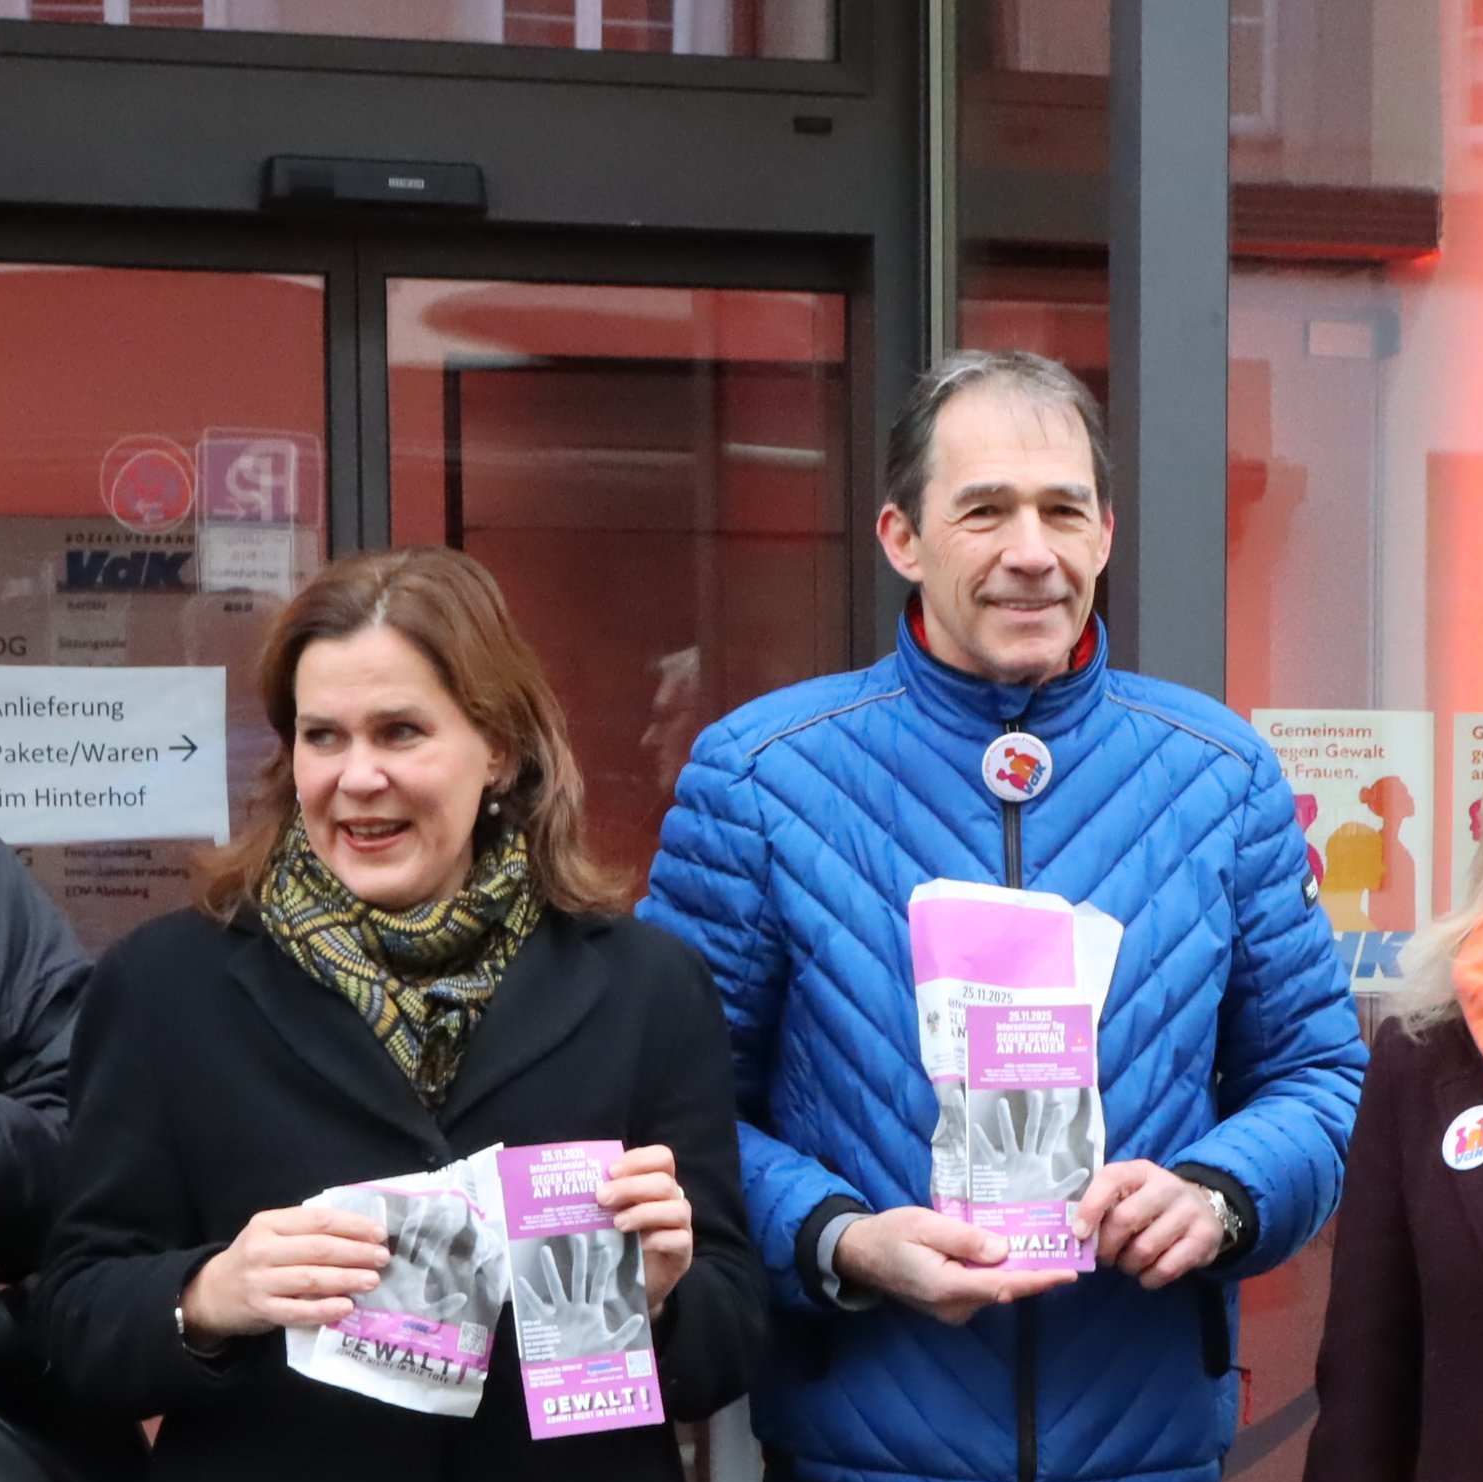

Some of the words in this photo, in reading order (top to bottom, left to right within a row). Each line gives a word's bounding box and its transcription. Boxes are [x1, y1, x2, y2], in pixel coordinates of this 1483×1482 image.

[65, 533, 196, 546] SOZIALVERBAND
[66, 551, 193, 589] VdK
[1270, 722, 1372, 738] Gemeinsam
[1325, 744, 1385, 758] Gewalt
[1295, 765, 1359, 779] Frauen.
[34, 786, 147, 808] Hinterhof
[962, 985, 1014, 1004] 25.11.2025
[1009, 1010, 1052, 1022] 25.11.2025
[996, 1021, 1051, 1032] Internationaler
[996, 1031, 1027, 1044] GEGEN
[1029, 1031, 1066, 1044] GEWALT
[996, 1042, 1014, 1055] AN
[1017, 1042, 1066, 1055] FRAUEN
[533, 1183, 551, 1199] AN
